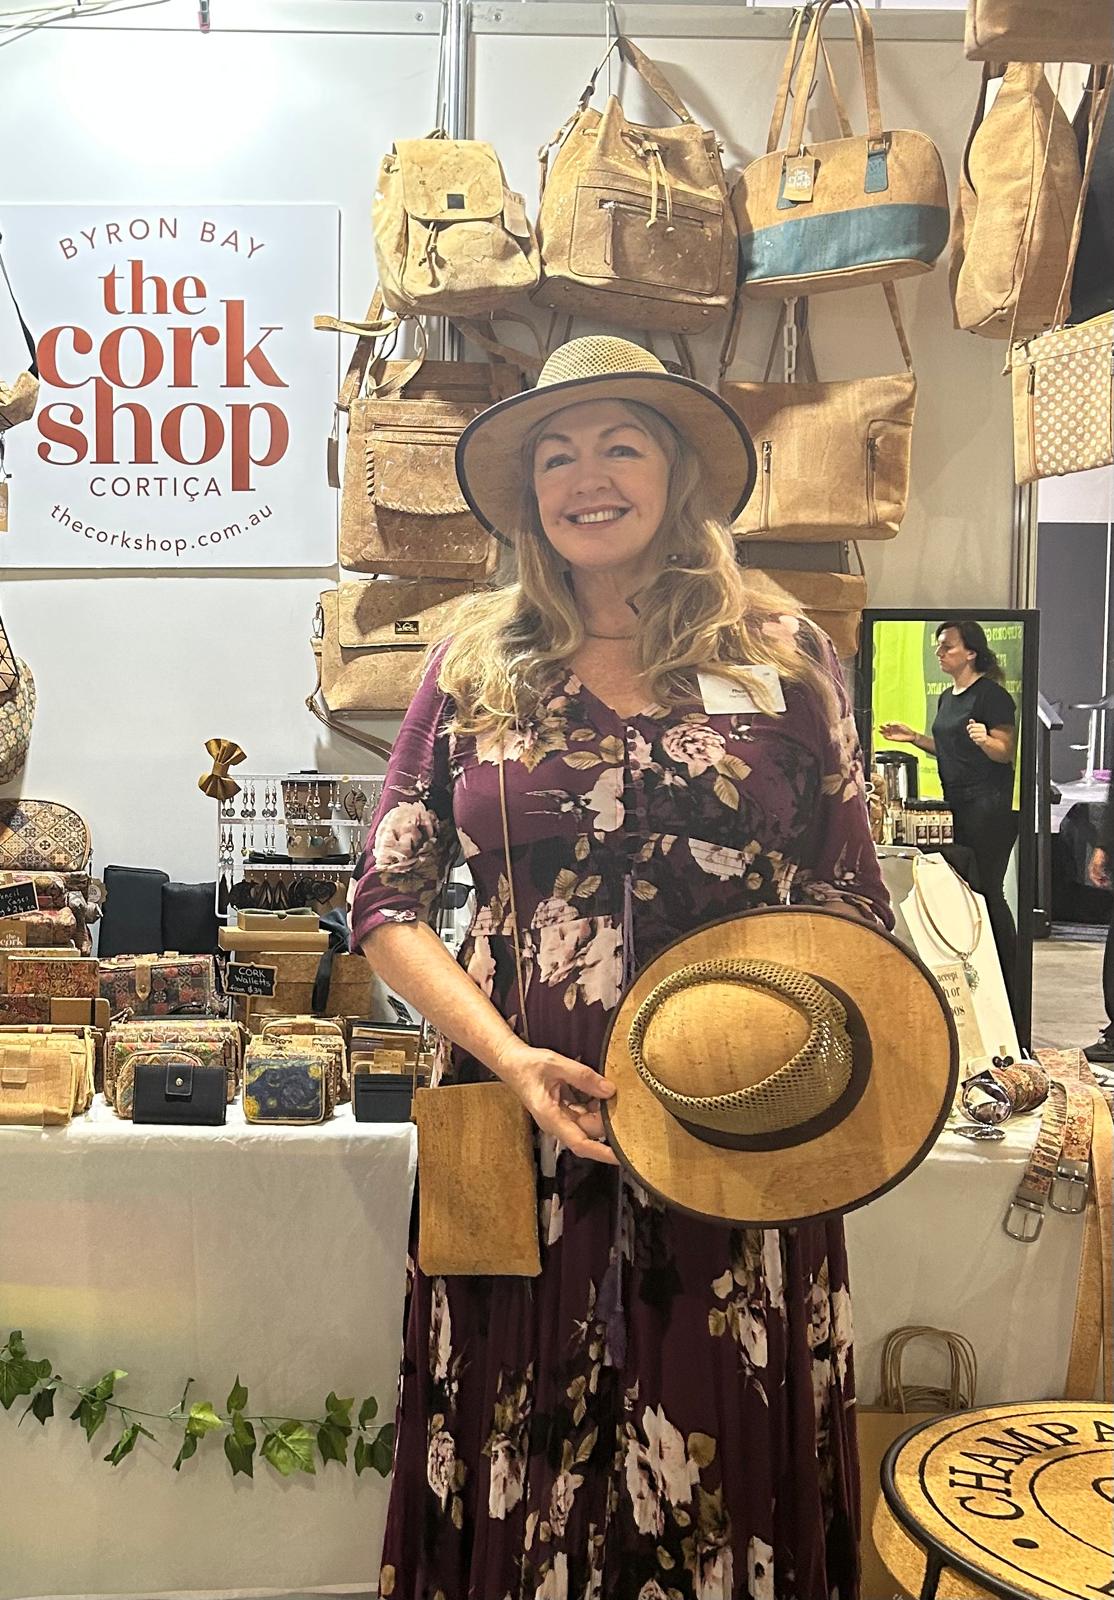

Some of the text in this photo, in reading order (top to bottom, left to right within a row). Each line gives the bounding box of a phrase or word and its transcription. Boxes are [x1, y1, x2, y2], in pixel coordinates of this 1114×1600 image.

[58, 217, 265, 260] BYRON BAY
[98, 259, 207, 315] the
[35, 299, 290, 389] cork
[37, 376, 289, 492] shop
[89, 476, 222, 502] CORTIÇA
[51, 504, 273, 556] thecorkshop.com.au
[238, 967, 266, 978] CORK
[950, 986, 960, 998] or
